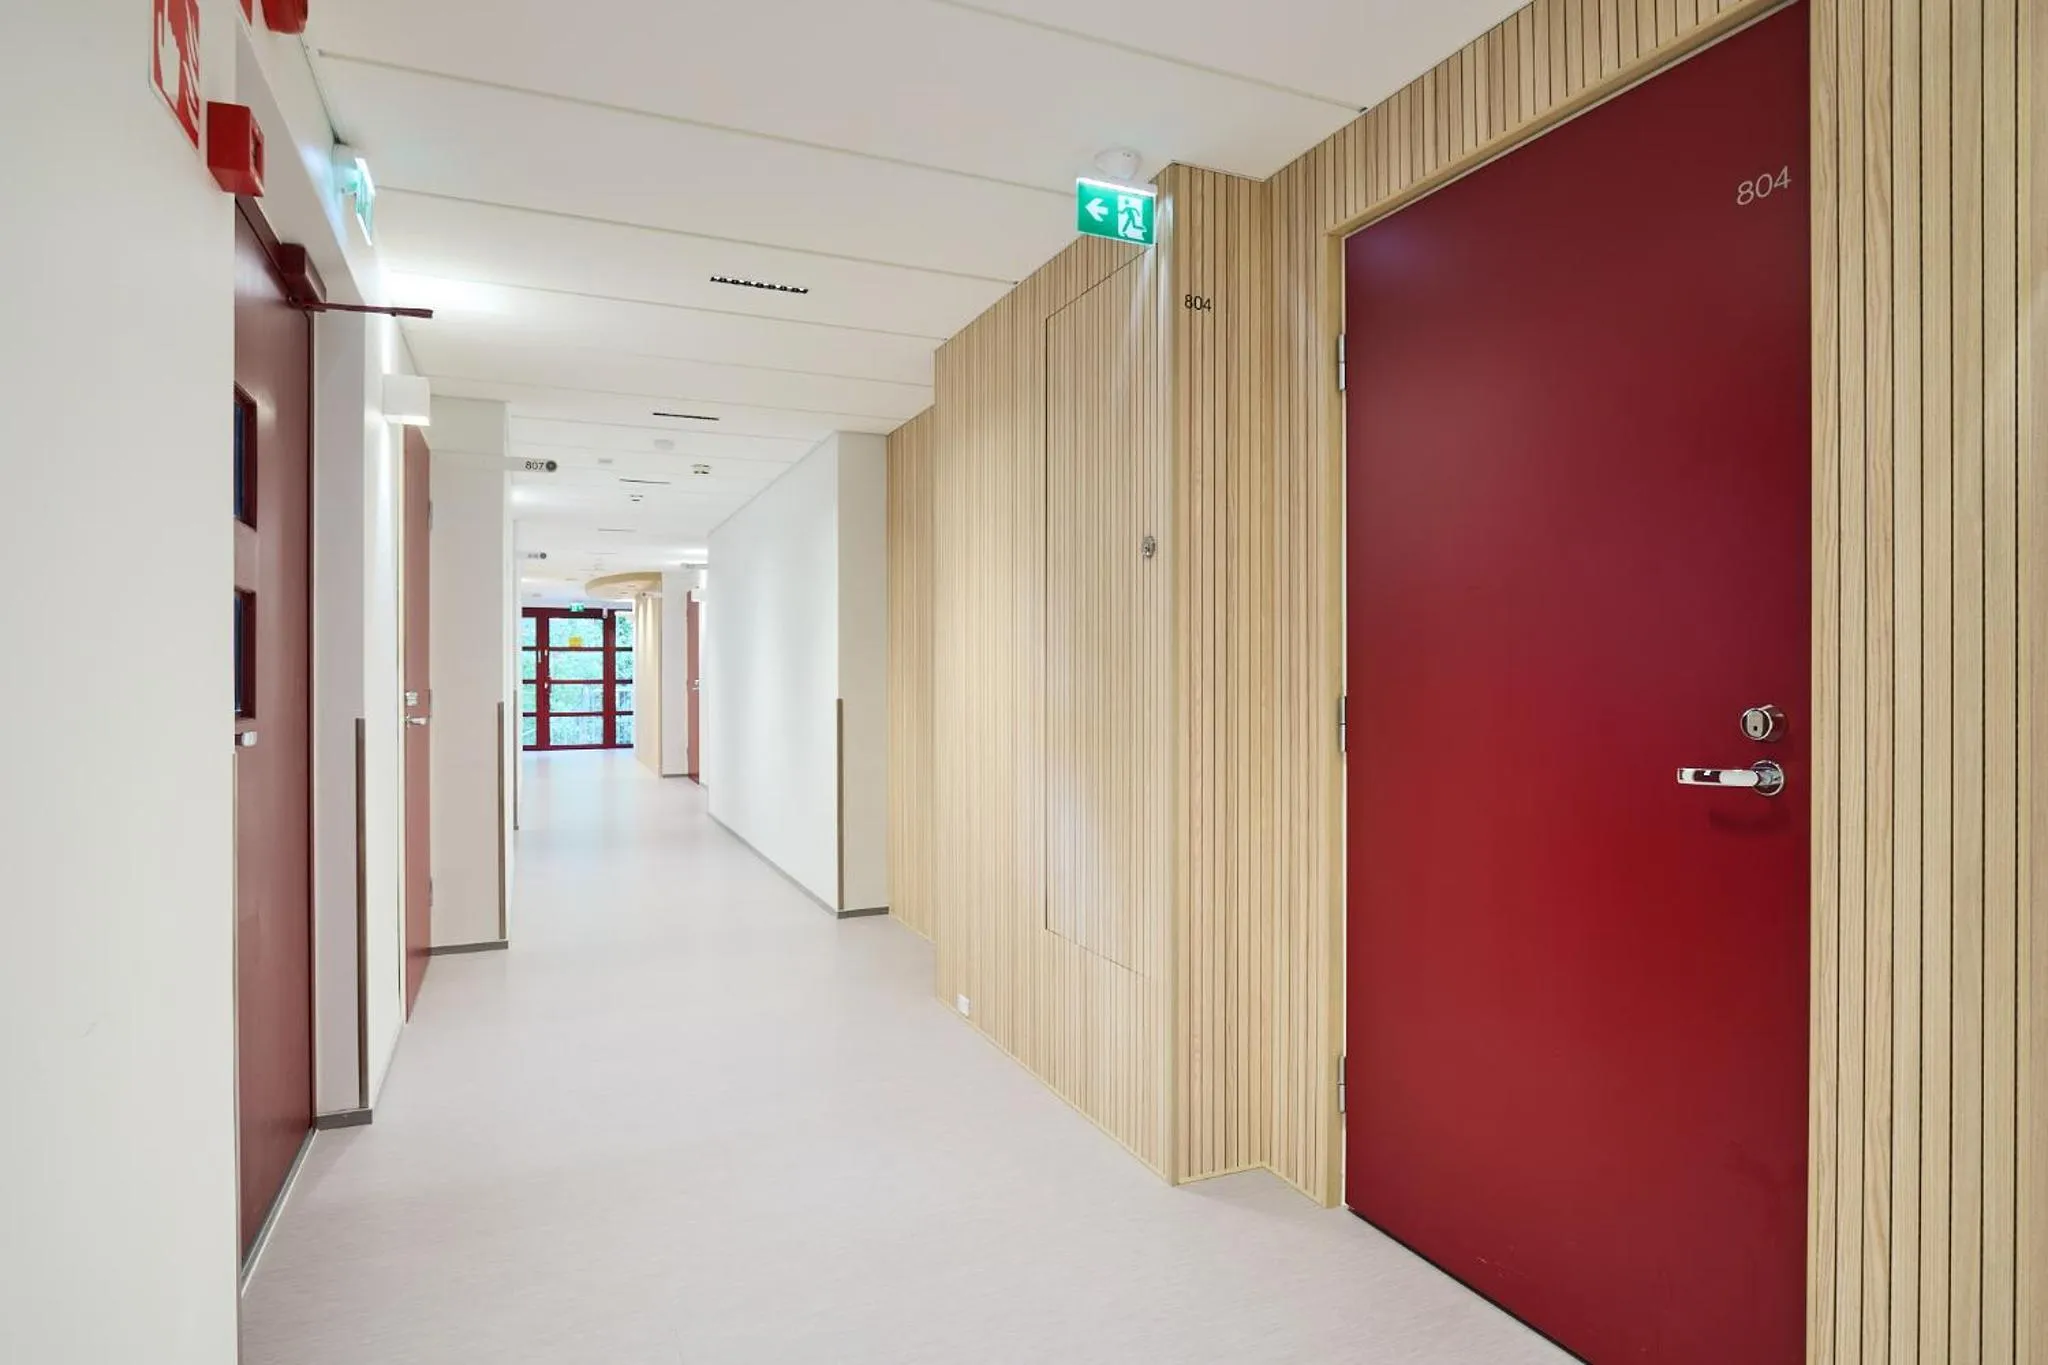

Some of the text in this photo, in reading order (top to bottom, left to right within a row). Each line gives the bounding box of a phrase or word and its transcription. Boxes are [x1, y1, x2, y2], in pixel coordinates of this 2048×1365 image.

[1737, 165, 1791, 205] 804
[1184, 294, 1212, 311] 804
[525, 460, 544, 470] 807
